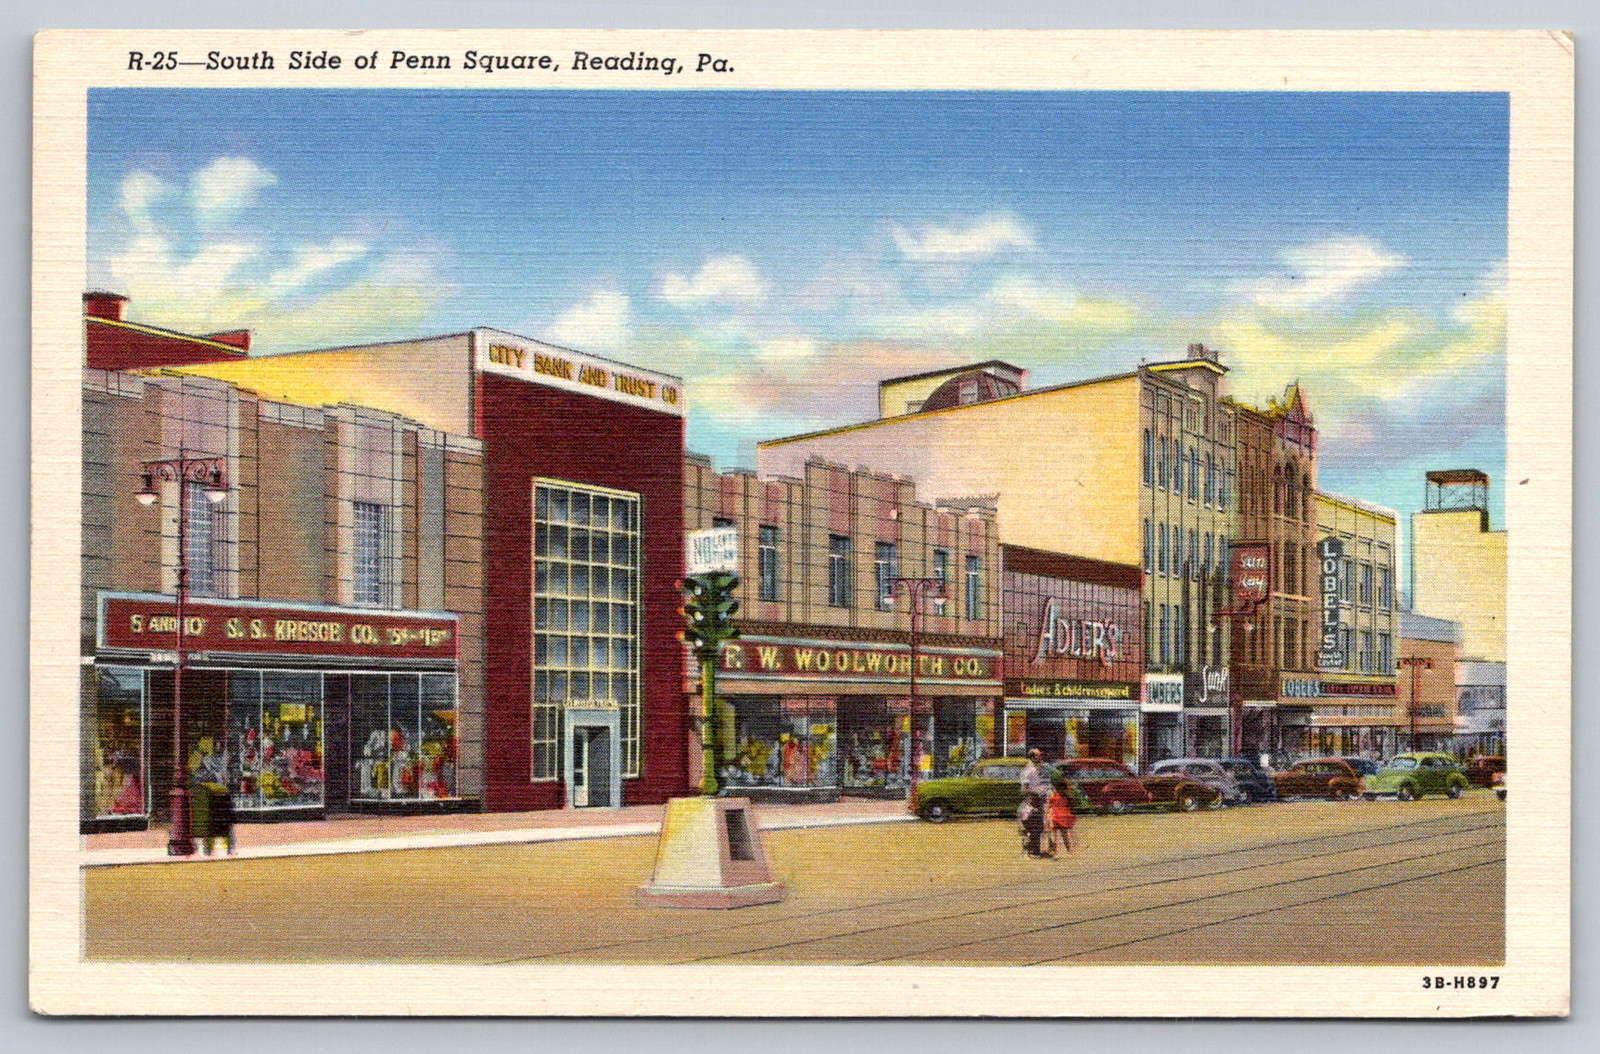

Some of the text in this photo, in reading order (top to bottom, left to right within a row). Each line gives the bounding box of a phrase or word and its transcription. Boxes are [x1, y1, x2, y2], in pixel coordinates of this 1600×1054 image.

[289, 50, 342, 70] Side
[354, 50, 379, 70] of
[390, 51, 451, 70] Penn
[463, 50, 560, 73] Square,
[572, 51, 684, 75] Reading,
[695, 53, 735, 73] Pa.
[489, 343, 677, 406] CITY BANK AND TRUST CO
[226, 617, 245, 639] S.
[250, 619, 267, 640] S.
[274, 620, 341, 642] KRESGE
[352, 624, 379, 645] CO.
[757, 646, 783, 669] W.
[795, 647, 942, 676] WOOLWORTH
[954, 657, 983, 677] CO.
[1422, 976, 1500, 989] 3B-H897
